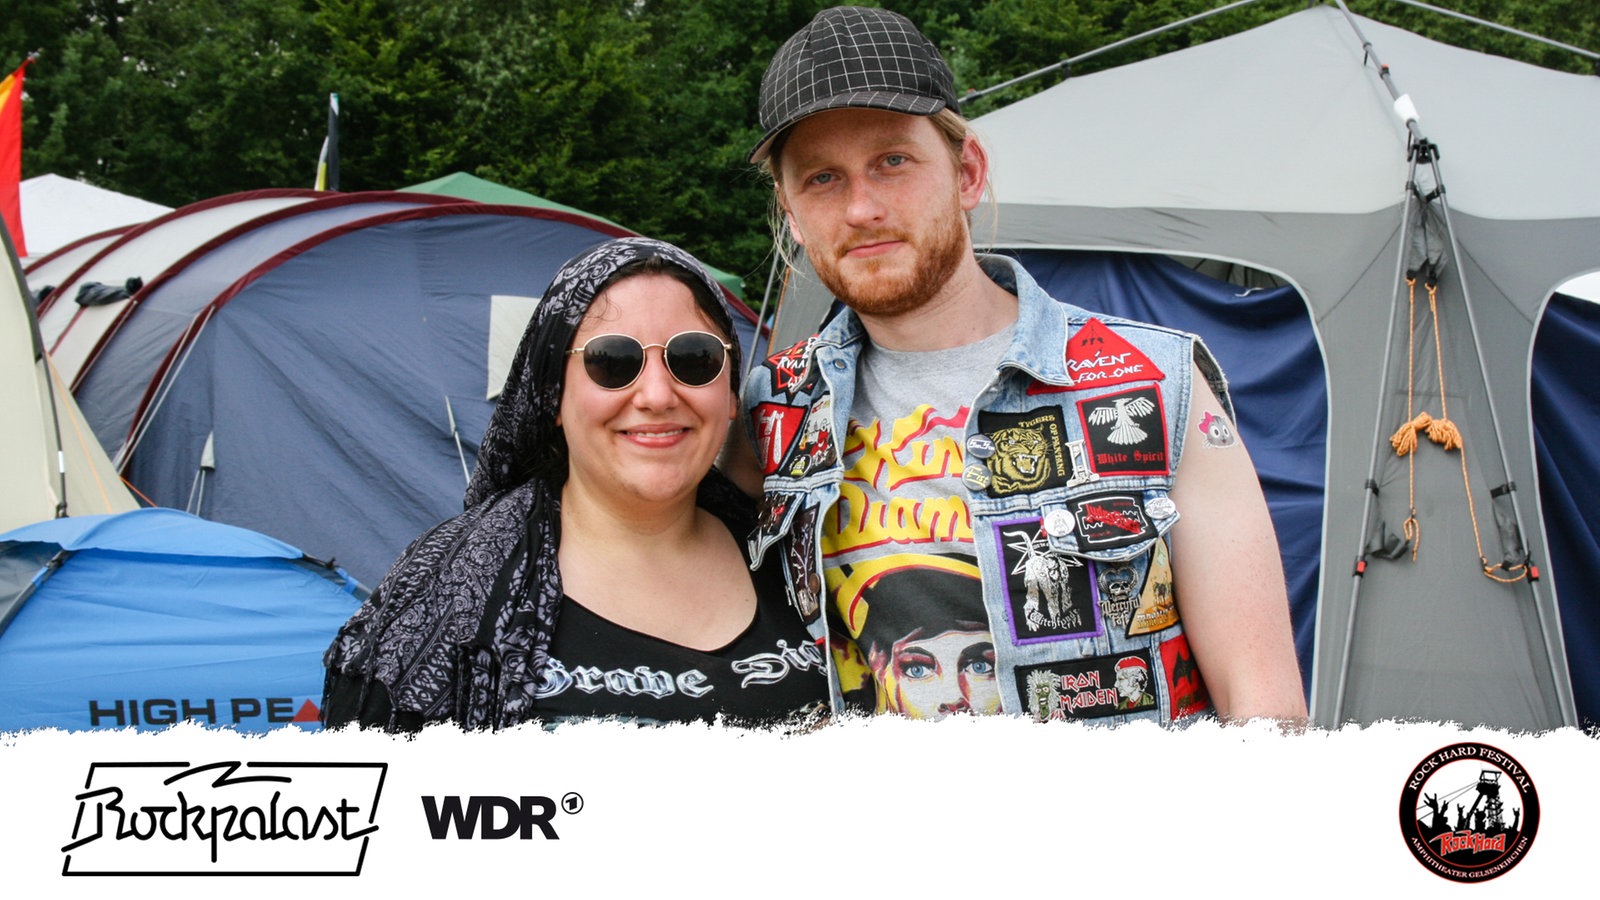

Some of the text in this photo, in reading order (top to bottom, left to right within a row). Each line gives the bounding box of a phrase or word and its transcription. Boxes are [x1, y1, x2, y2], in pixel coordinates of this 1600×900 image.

[1110, 365, 1143, 378] ONE
[821, 482, 975, 559] Diam
[1061, 671, 1100, 692] IRON
[89, 698, 216, 726] HIGH
[1059, 688, 1118, 713] MAIDEN
